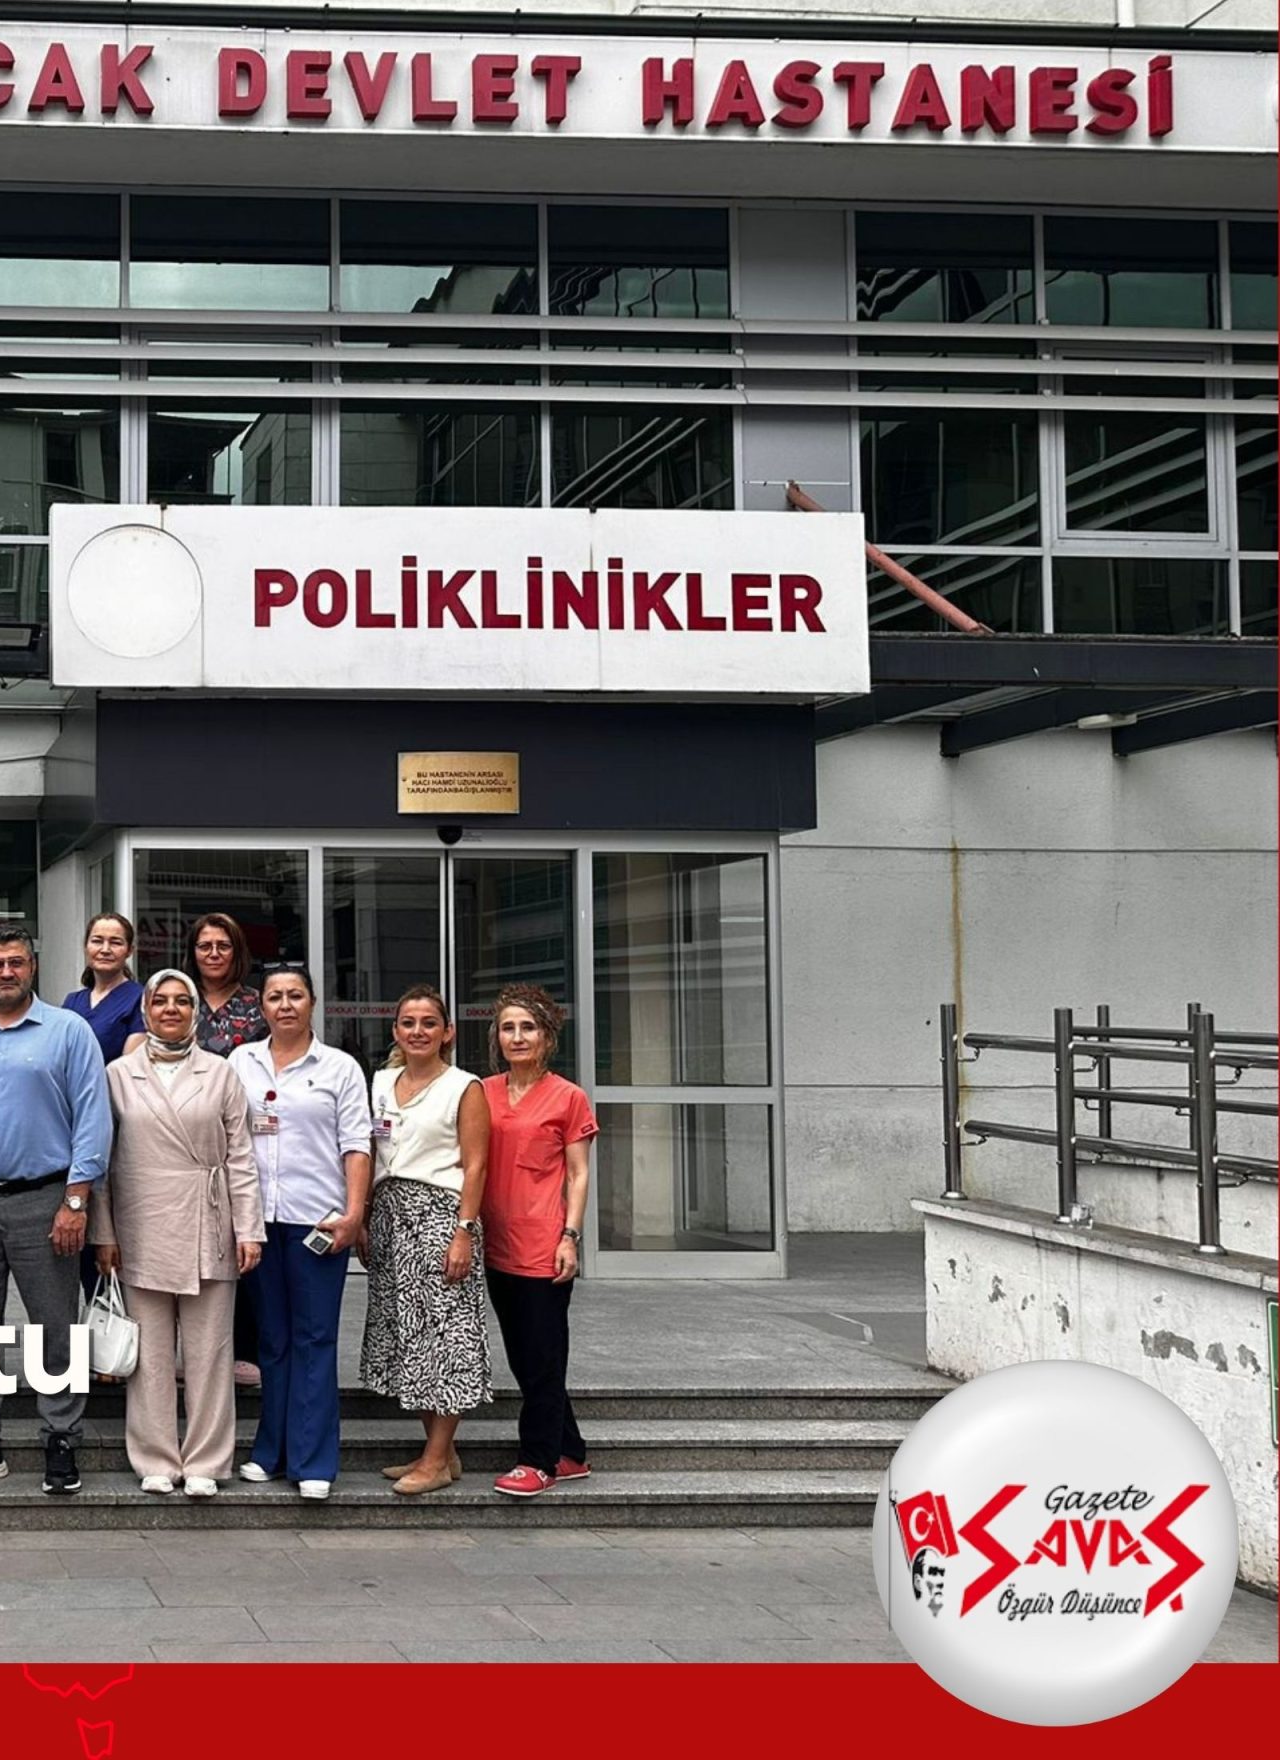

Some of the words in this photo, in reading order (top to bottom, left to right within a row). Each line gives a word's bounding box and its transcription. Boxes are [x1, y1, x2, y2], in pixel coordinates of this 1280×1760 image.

[218, 47, 582, 125] DEVLET
[641, 55, 1173, 136] HASTANESİ
[255, 556, 824, 633] POLİKLİNİKLER
[416, 771, 428, 779] BU
[412, 779, 430, 787] HACI
[360, 1006, 396, 1015] OTOMAT
[466, 1006, 495, 1017] DİKKA
